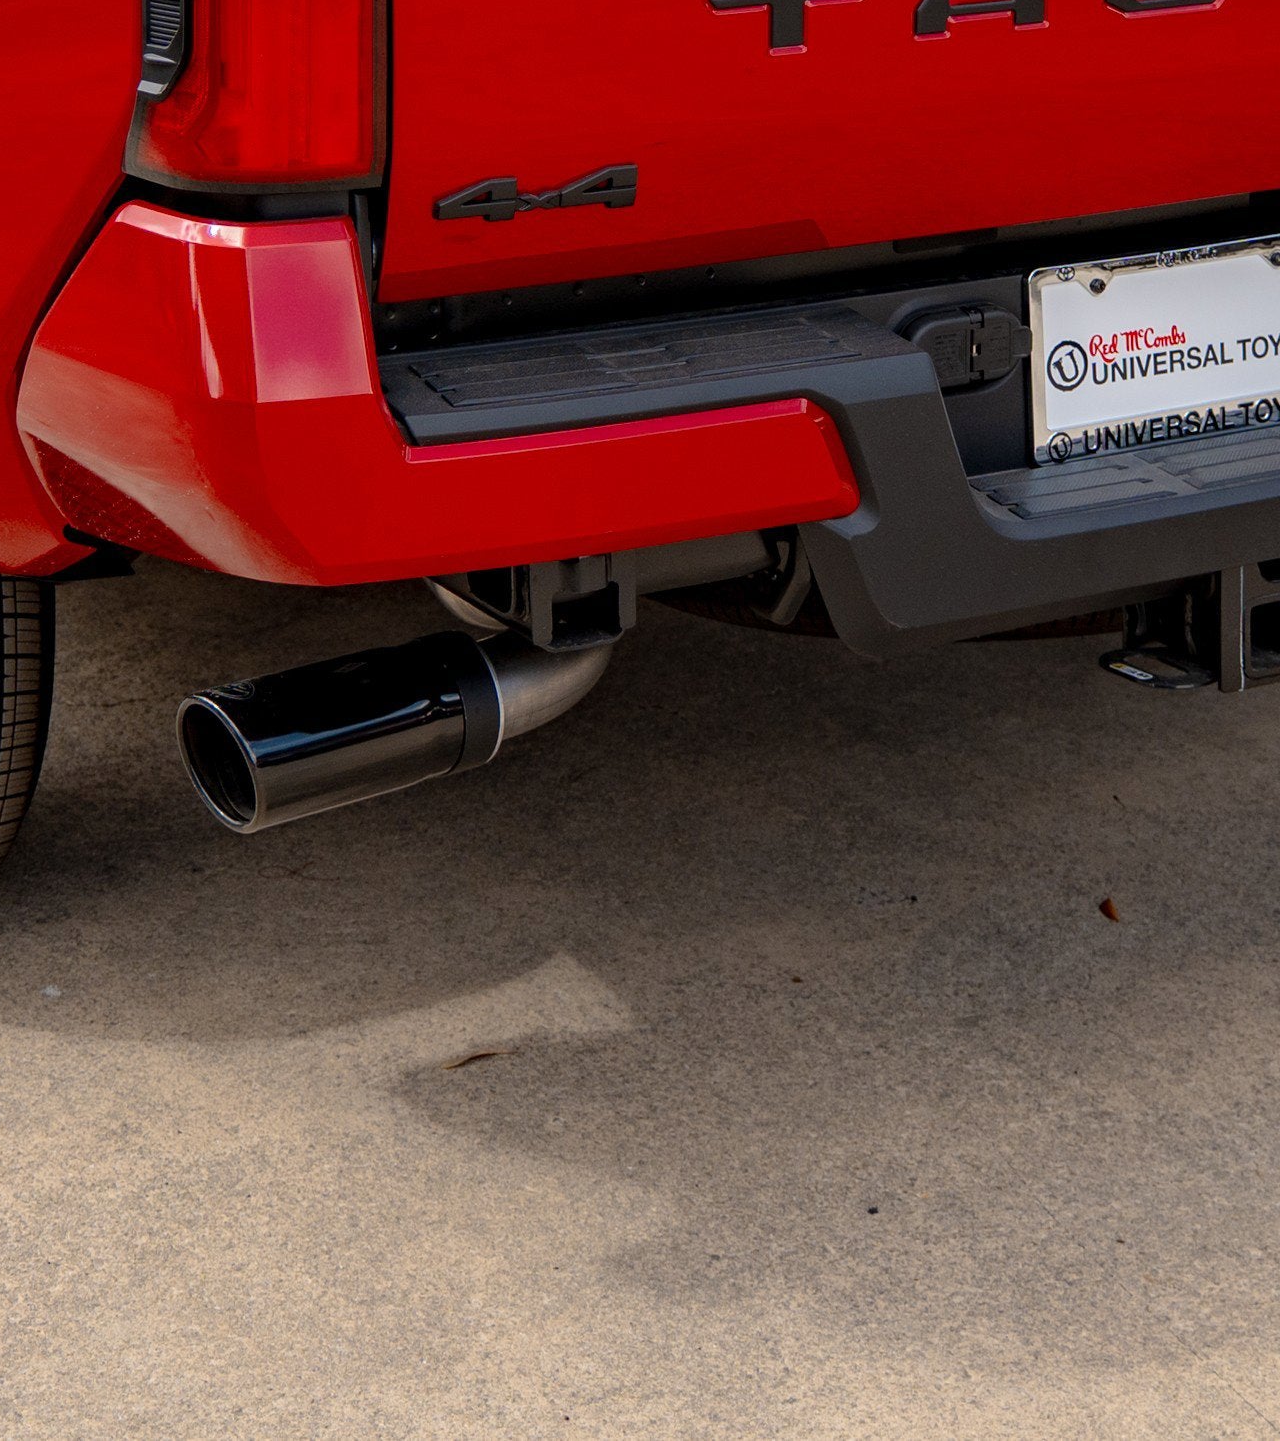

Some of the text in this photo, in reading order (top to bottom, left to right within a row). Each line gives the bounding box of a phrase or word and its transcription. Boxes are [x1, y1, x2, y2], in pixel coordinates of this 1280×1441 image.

[1089, 324, 1186, 363] Red McCombs
[1091, 342, 1234, 386] UNIVERSAL
[1082, 406, 1235, 454] UNIVERSAL
